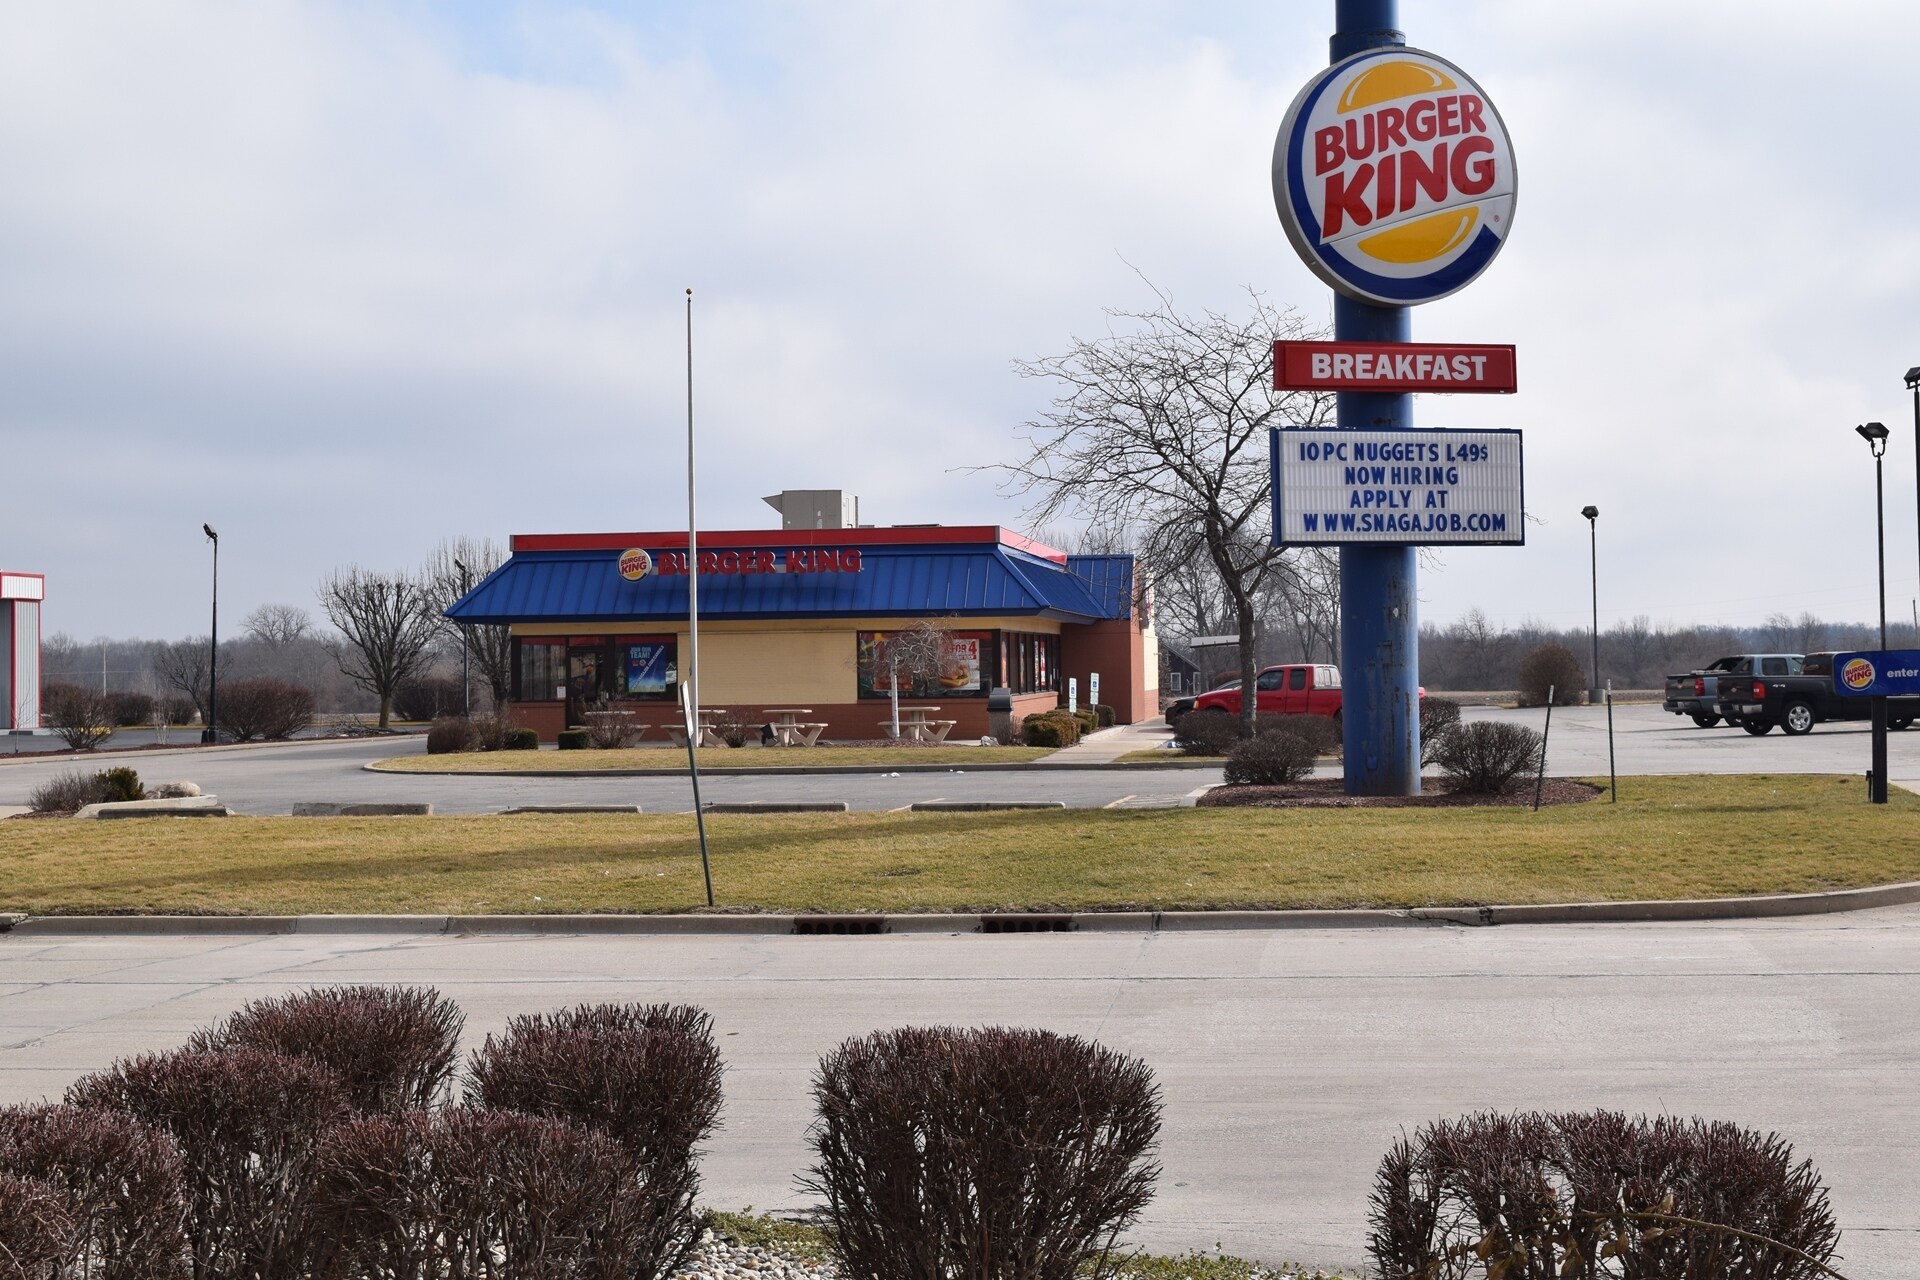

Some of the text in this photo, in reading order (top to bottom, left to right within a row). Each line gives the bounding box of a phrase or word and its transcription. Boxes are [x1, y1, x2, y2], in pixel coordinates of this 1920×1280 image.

[1315, 95, 1486, 176] BURGER
[1322, 136, 1495, 238] KING
[1311, 353, 1487, 381] BREAKFAST
[1354, 443, 1440, 462] NUGGETS
[1345, 466, 1459, 486] NOW HIRING
[1350, 490, 1449, 509] APPLY AT
[620, 555, 647, 567] BURGER
[621, 561, 648, 574] KING
[658, 548, 861, 575] BURGER KING
[1845, 663, 1870, 677] BURGER
[1846, 669, 1872, 685] KING
[1887, 668, 1919, 678] enter
